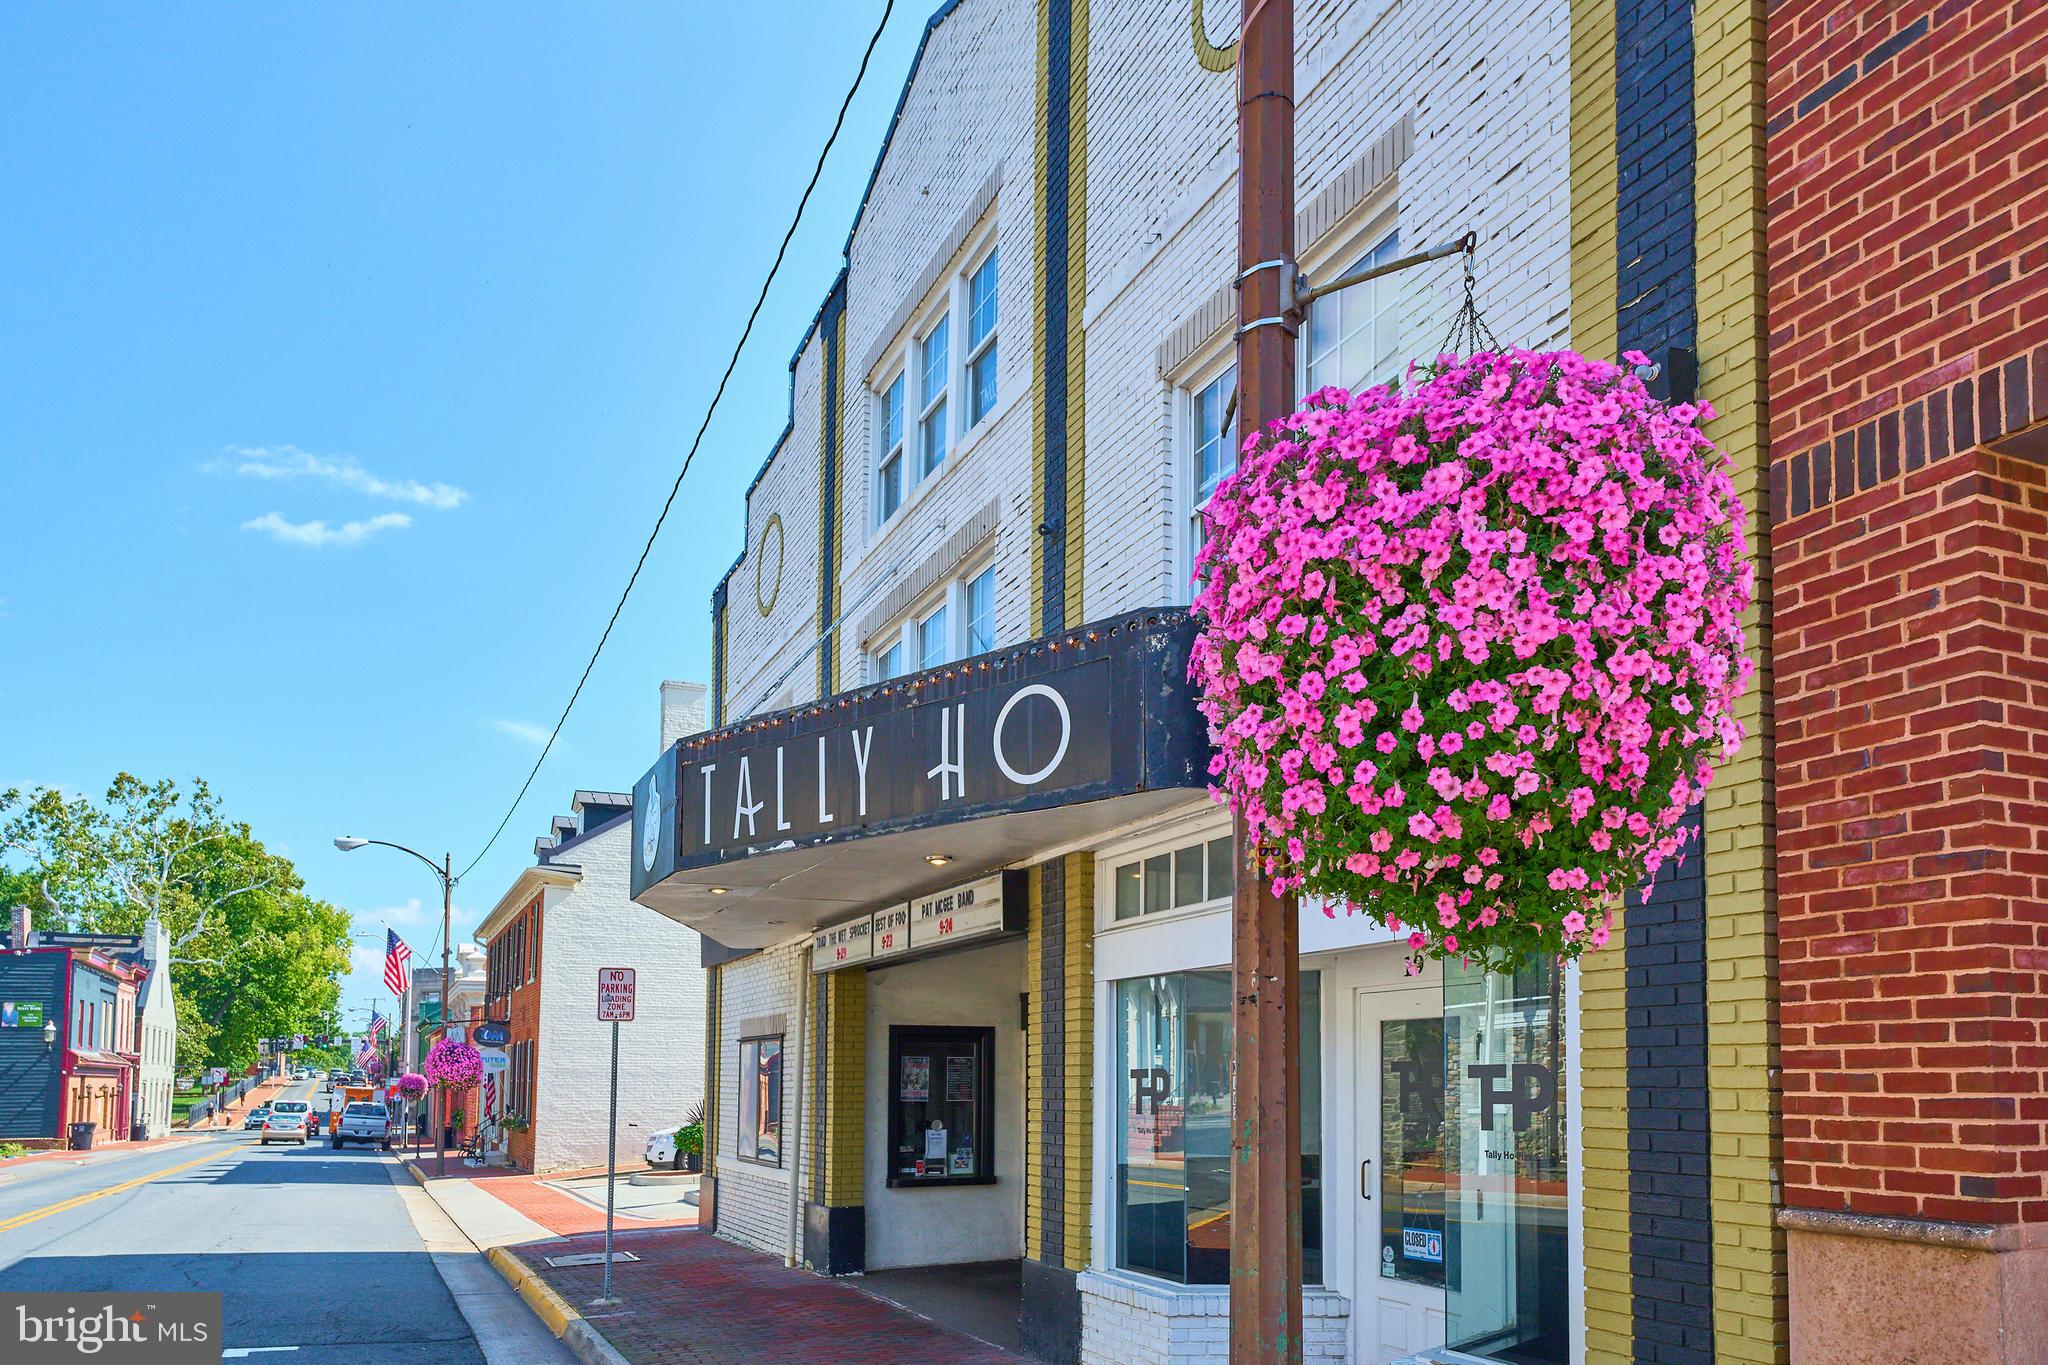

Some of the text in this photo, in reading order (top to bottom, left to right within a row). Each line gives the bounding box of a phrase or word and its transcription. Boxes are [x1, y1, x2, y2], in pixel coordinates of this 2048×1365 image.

[700, 684, 1071, 845] TALLY HO
[921, 889, 975, 919] PAT MCGEE BAND
[874, 916, 886, 933] BEST
[887, 913, 895, 929] OF
[939, 917, 953, 935] 9-24
[828, 931, 837, 945] THE
[837, 928, 847, 943] WET
[849, 921, 871, 939] SPROCKET
[881, 934, 893, 949] 9-23
[610, 971, 624, 981] NO
[600, 983, 633, 994] PARKING
[601, 995, 632, 1003] LADING
[607, 1003, 625, 1011] ZONE
[1484, 1150, 1502, 1161] Tally
[1503, 1151, 1515, 1160] Ho
[1404, 1231, 1427, 1248] CLOSED
